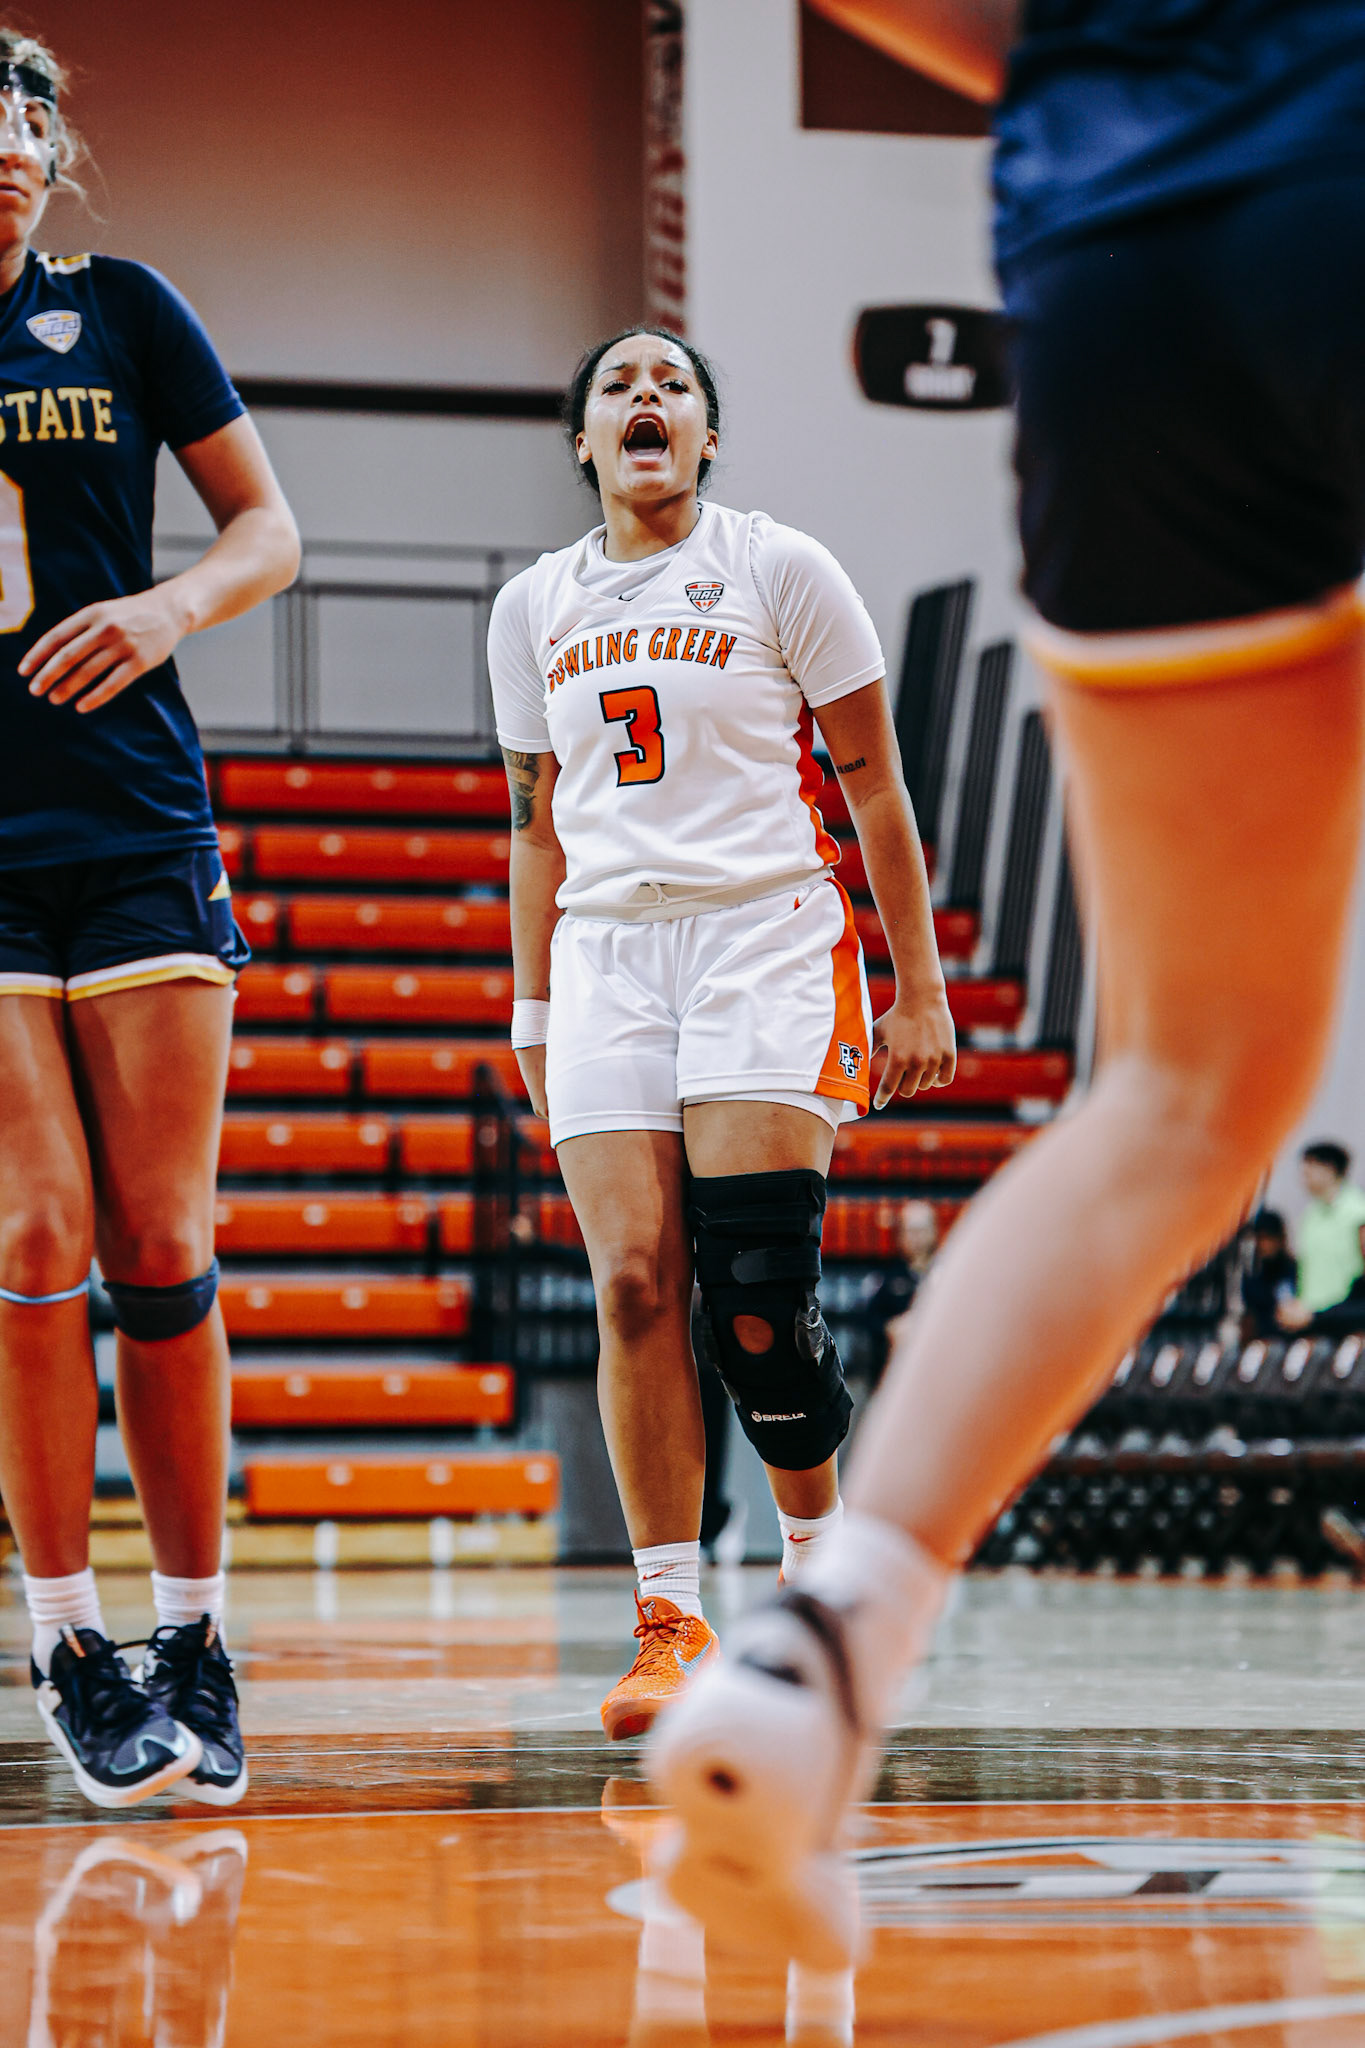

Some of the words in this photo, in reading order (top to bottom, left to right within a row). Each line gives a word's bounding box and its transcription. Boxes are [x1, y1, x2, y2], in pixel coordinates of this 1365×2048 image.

[0, 387, 118, 444] TATE
[688, 589, 722, 600] MAC
[648, 627, 738, 670] GREEN
[598, 685, 665, 788] 3
